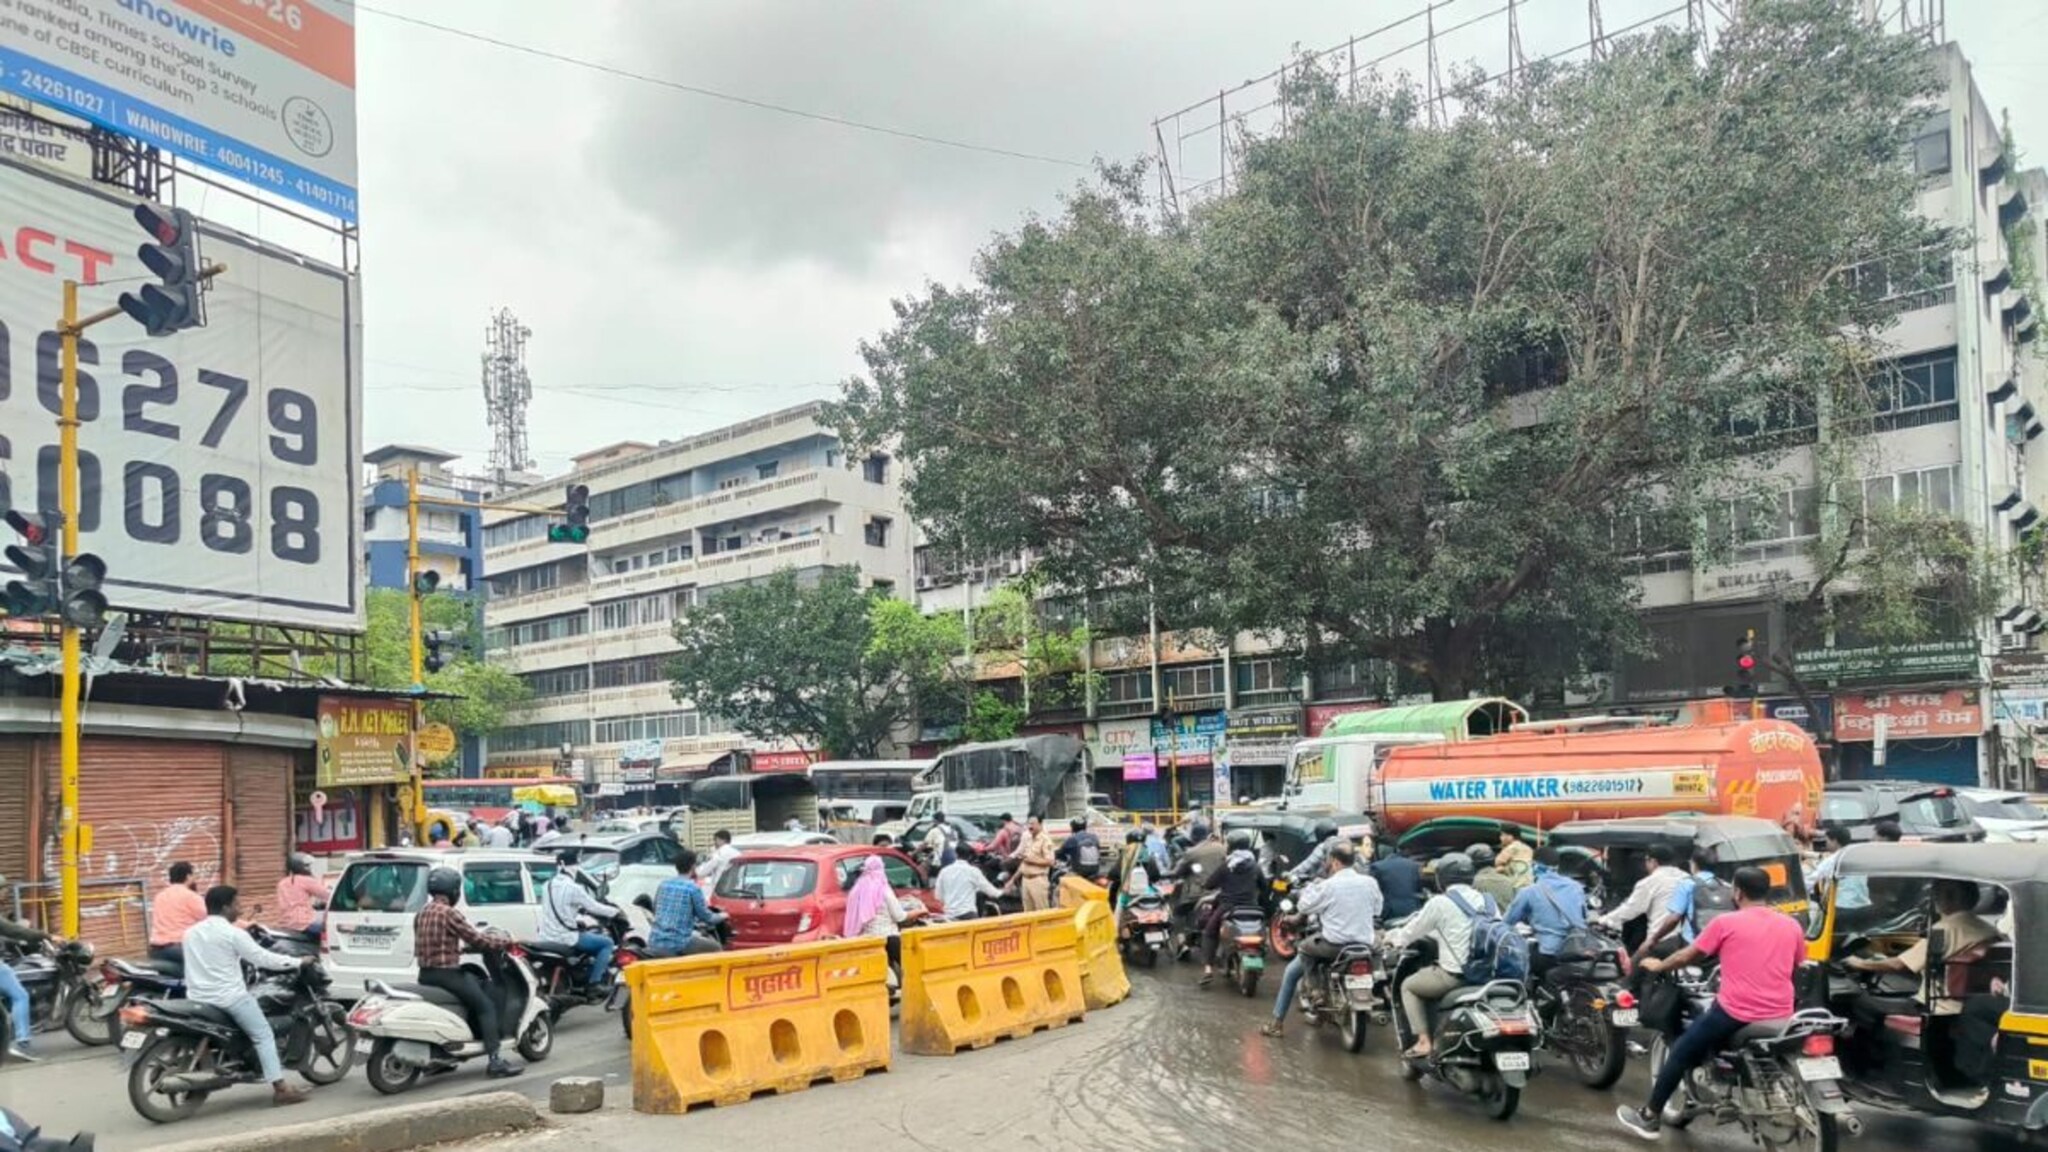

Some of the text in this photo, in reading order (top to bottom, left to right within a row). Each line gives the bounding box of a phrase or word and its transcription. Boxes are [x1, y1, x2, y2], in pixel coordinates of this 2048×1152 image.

[17, 0, 278, 121] ranked among the top 3 schools
[34, 28, 51, 45] of
[56, 36, 100, 63] CBSE
[104, 57, 195, 104] curriculum
[98, 10, 148, 44] Times
[207, 61, 257, 96] Survey
[21, 68, 104, 115] 24261027
[0, 433, 322, 566] 0088
[1105, 730, 1136, 745] CITY
[1430, 780, 1487, 800] WATER
[1492, 778, 1559, 799] TANKER
[743, 965, 803, 1003] पुढारी
